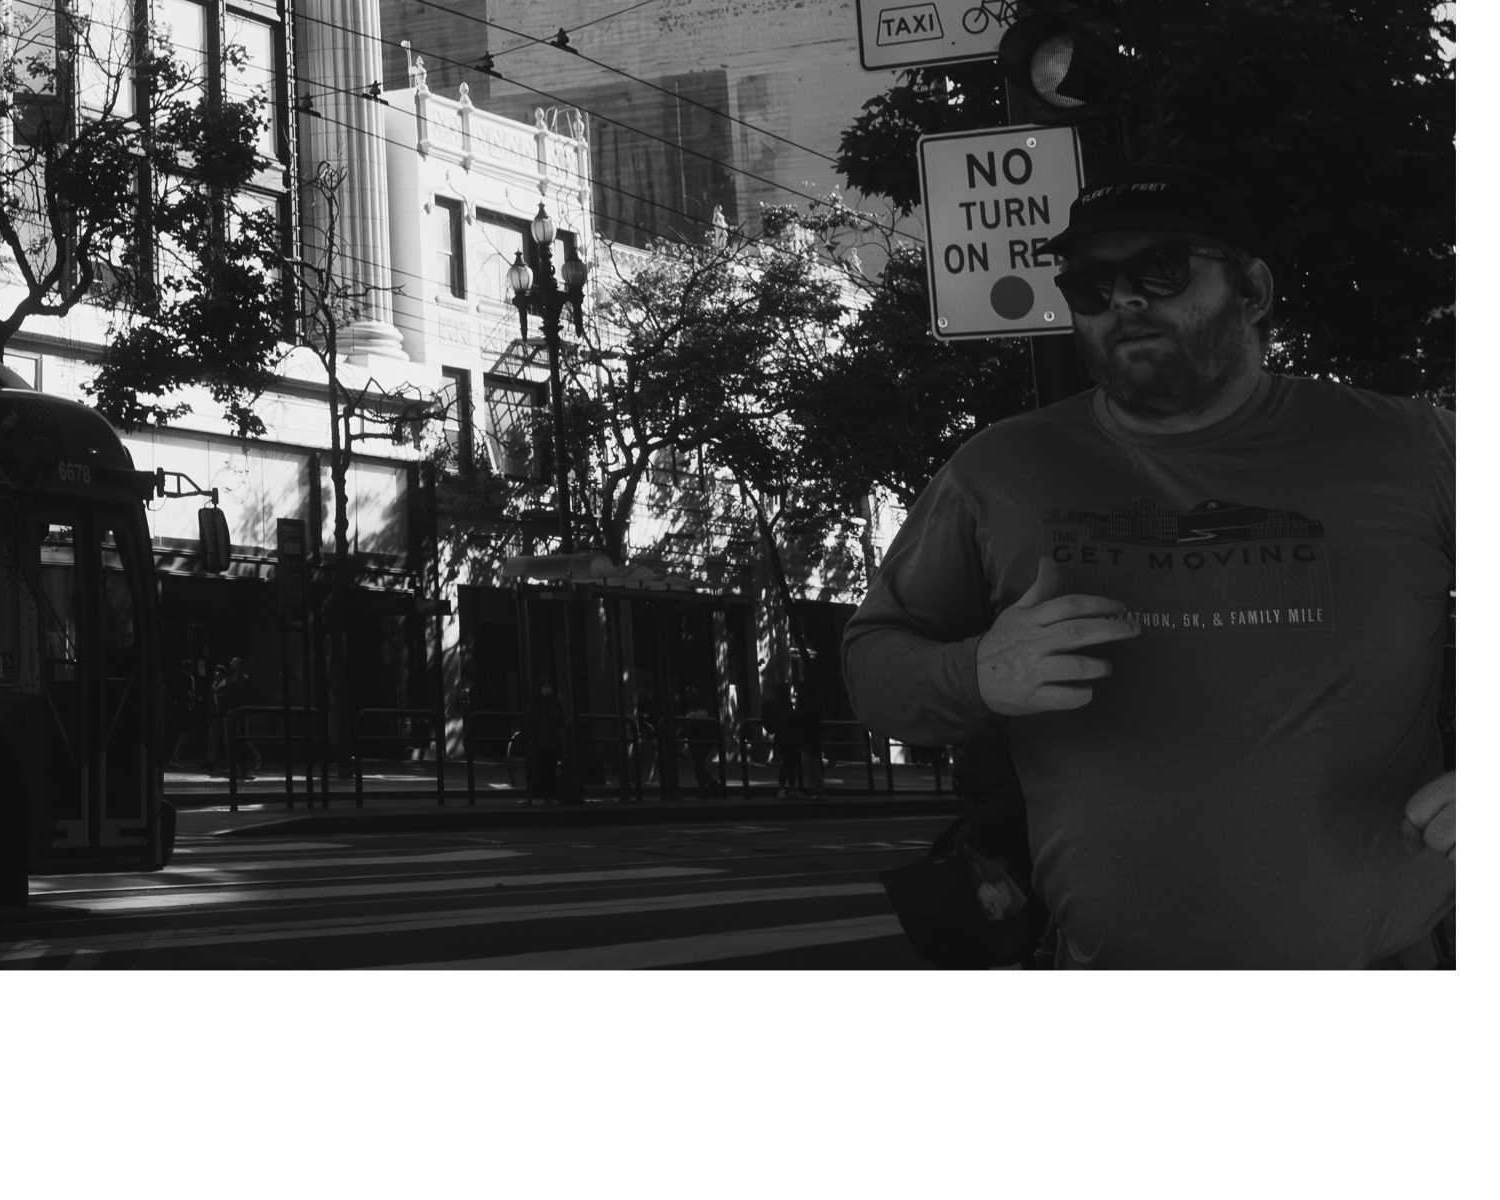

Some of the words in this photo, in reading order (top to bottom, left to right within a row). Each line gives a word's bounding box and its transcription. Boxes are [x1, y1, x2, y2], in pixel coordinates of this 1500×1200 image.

[882, 12, 935, 37] TAXI
[965, 147, 1033, 189] NO
[1081, 185, 1114, 206] FLEET
[1131, 182, 1168, 192] FEET
[958, 194, 1051, 232] TURN
[943, 241, 990, 274] ON
[1008, 237, 1064, 270] RE
[58, 460, 91, 484] 6678
[1051, 545, 1125, 567] GET
[1149, 543, 1317, 571] MOVING
[1183, 612, 1206, 629] 5K,
[1212, 612, 1224, 627] &
[1230, 609, 1281, 626] FAMILY
[1288, 607, 1324, 623] MILE
